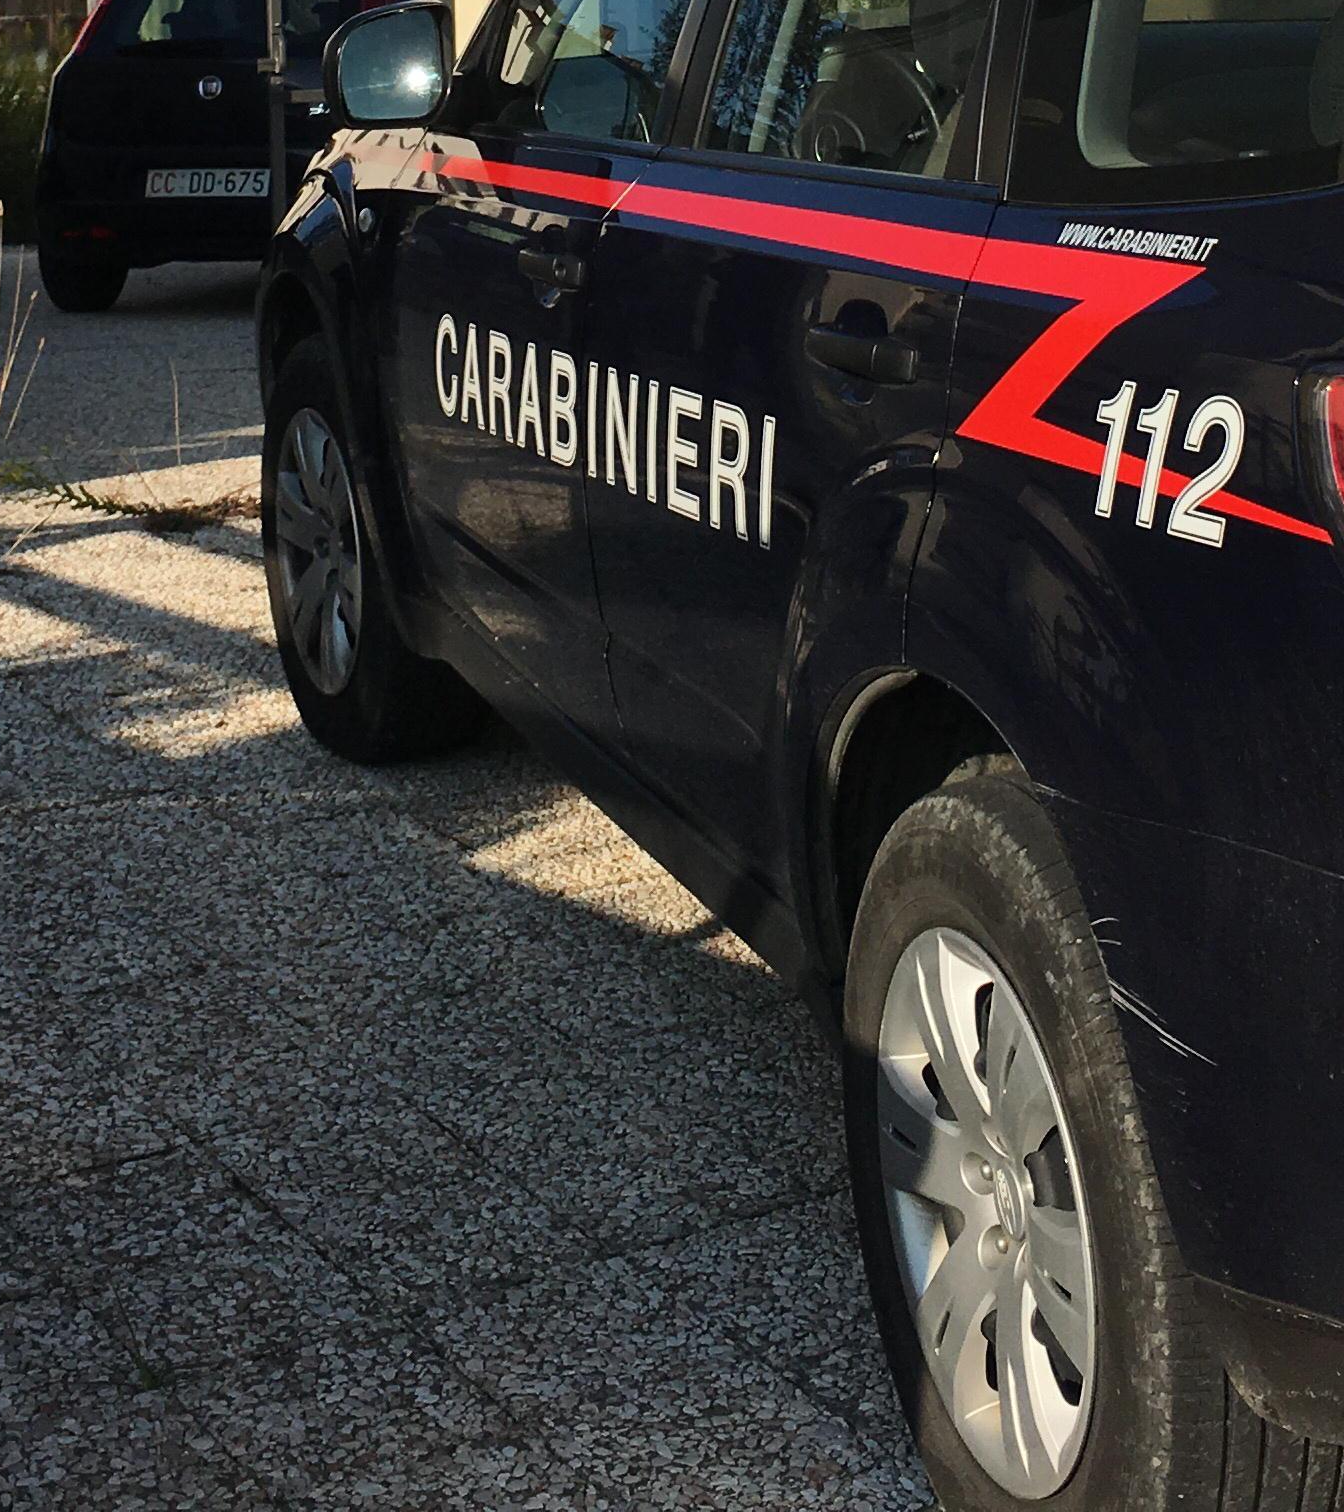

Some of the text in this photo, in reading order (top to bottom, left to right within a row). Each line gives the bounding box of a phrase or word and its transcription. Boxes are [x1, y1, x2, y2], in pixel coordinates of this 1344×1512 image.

[150, 171, 177, 194] CC
[1057, 222, 1219, 262] WWW.CARABINIERI.IT
[433, 313, 777, 550] CARABINIERI
[1095, 380, 1247, 547] 112
